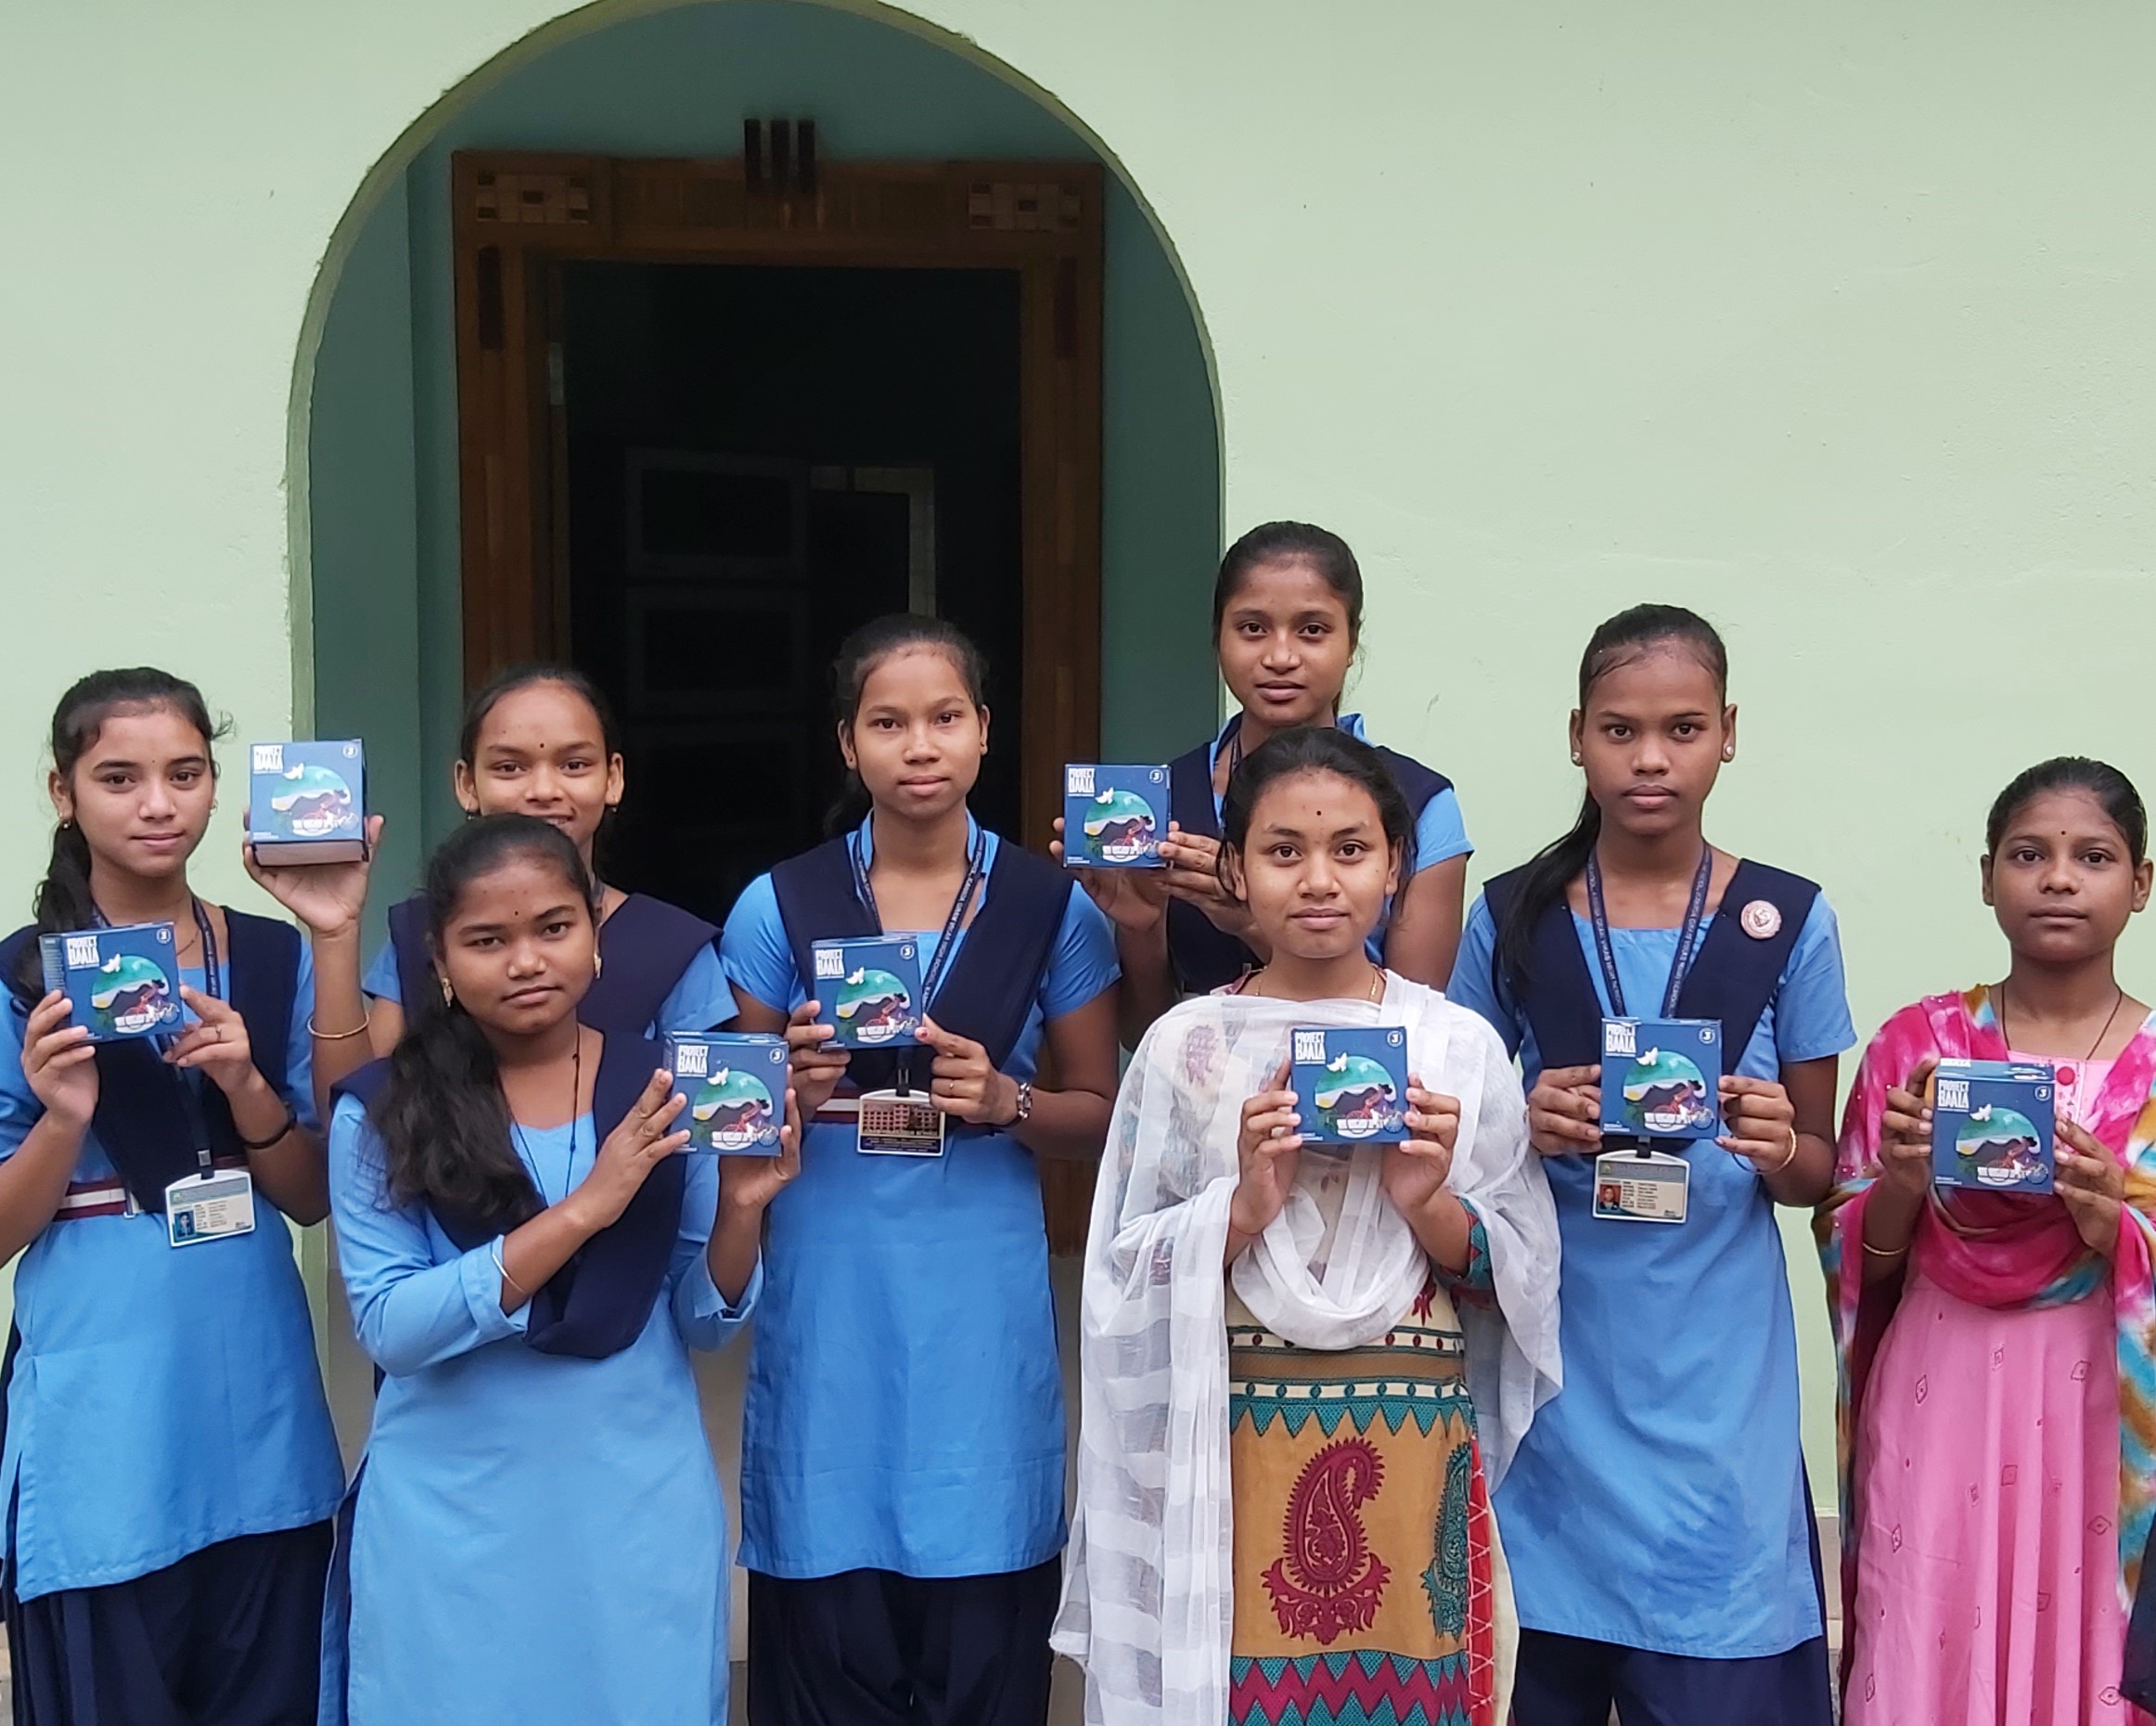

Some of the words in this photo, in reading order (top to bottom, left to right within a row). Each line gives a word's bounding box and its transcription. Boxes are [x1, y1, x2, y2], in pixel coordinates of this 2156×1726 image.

[1068, 768, 1095, 779] PROJECT
[815, 948, 843, 960] PROJECT
[1606, 1024, 1636, 1036] PROJECT
[1295, 1032, 1325, 1043] PROJECT
[678, 1045, 709, 1057] PROJECT
[1938, 1080, 1970, 1091] PROJECT
